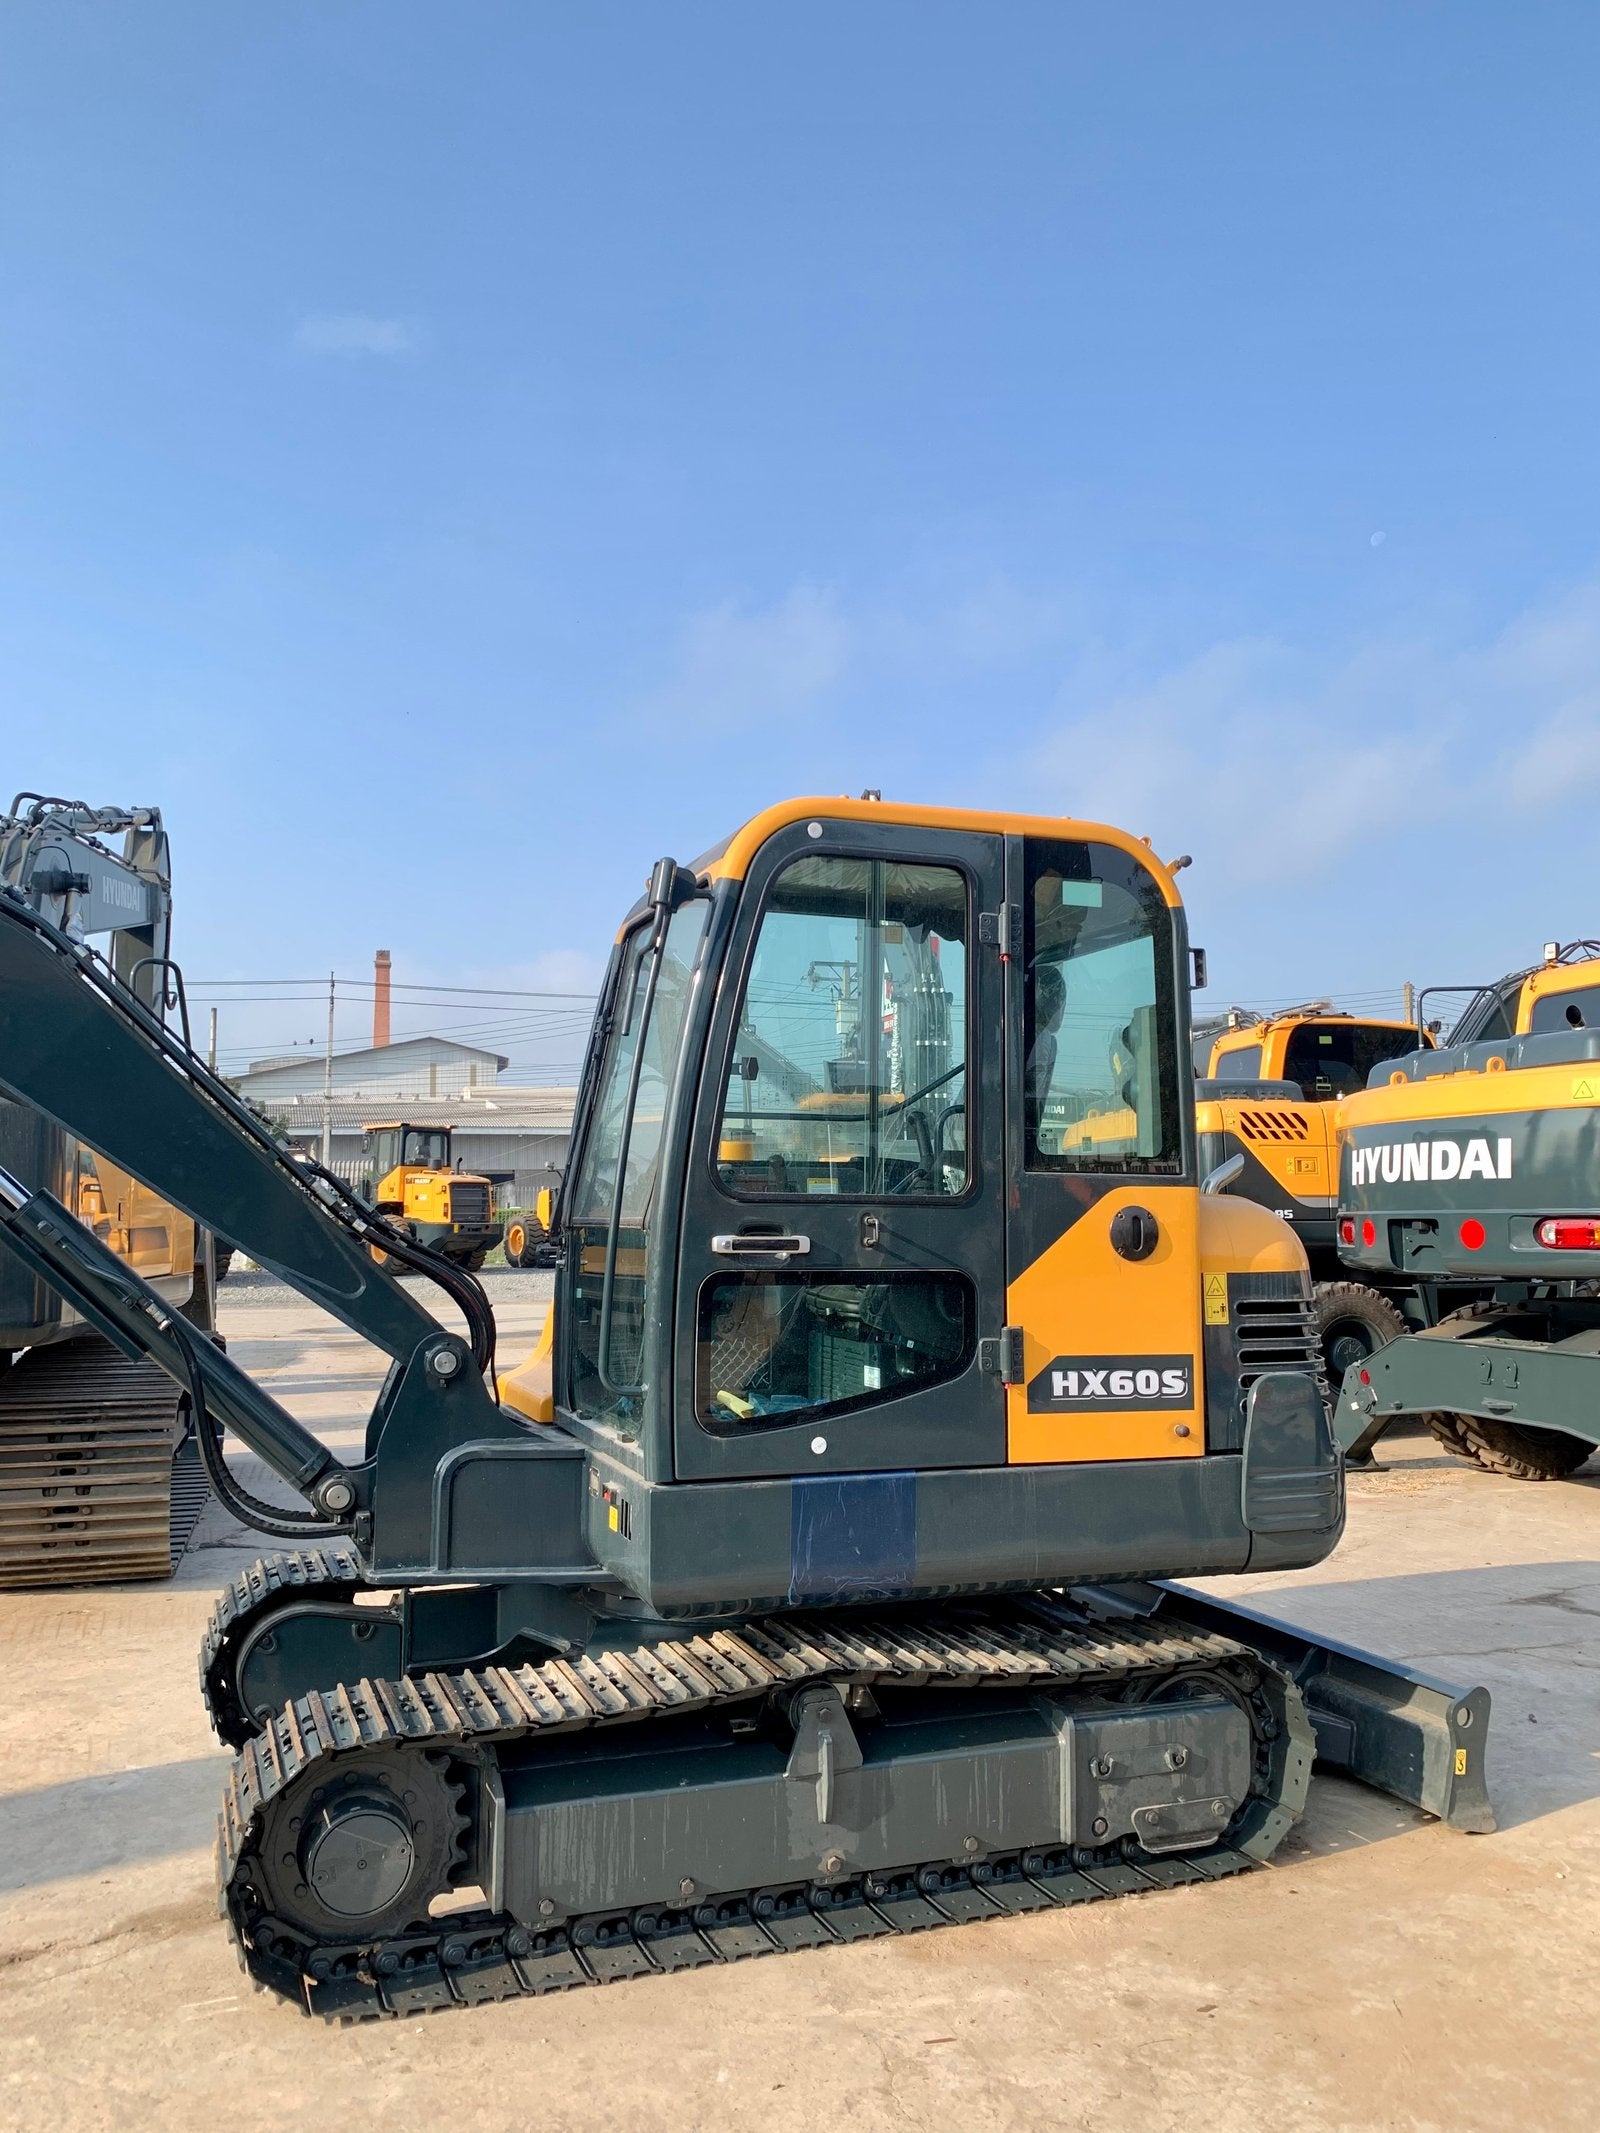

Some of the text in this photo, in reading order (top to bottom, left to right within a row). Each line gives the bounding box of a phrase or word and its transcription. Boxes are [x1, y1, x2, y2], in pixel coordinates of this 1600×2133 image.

[103, 876, 139, 912] HYUNDAI
[1352, 1138, 1512, 1186] HYUNDAI
[1051, 1369, 1188, 1399] HX60S
